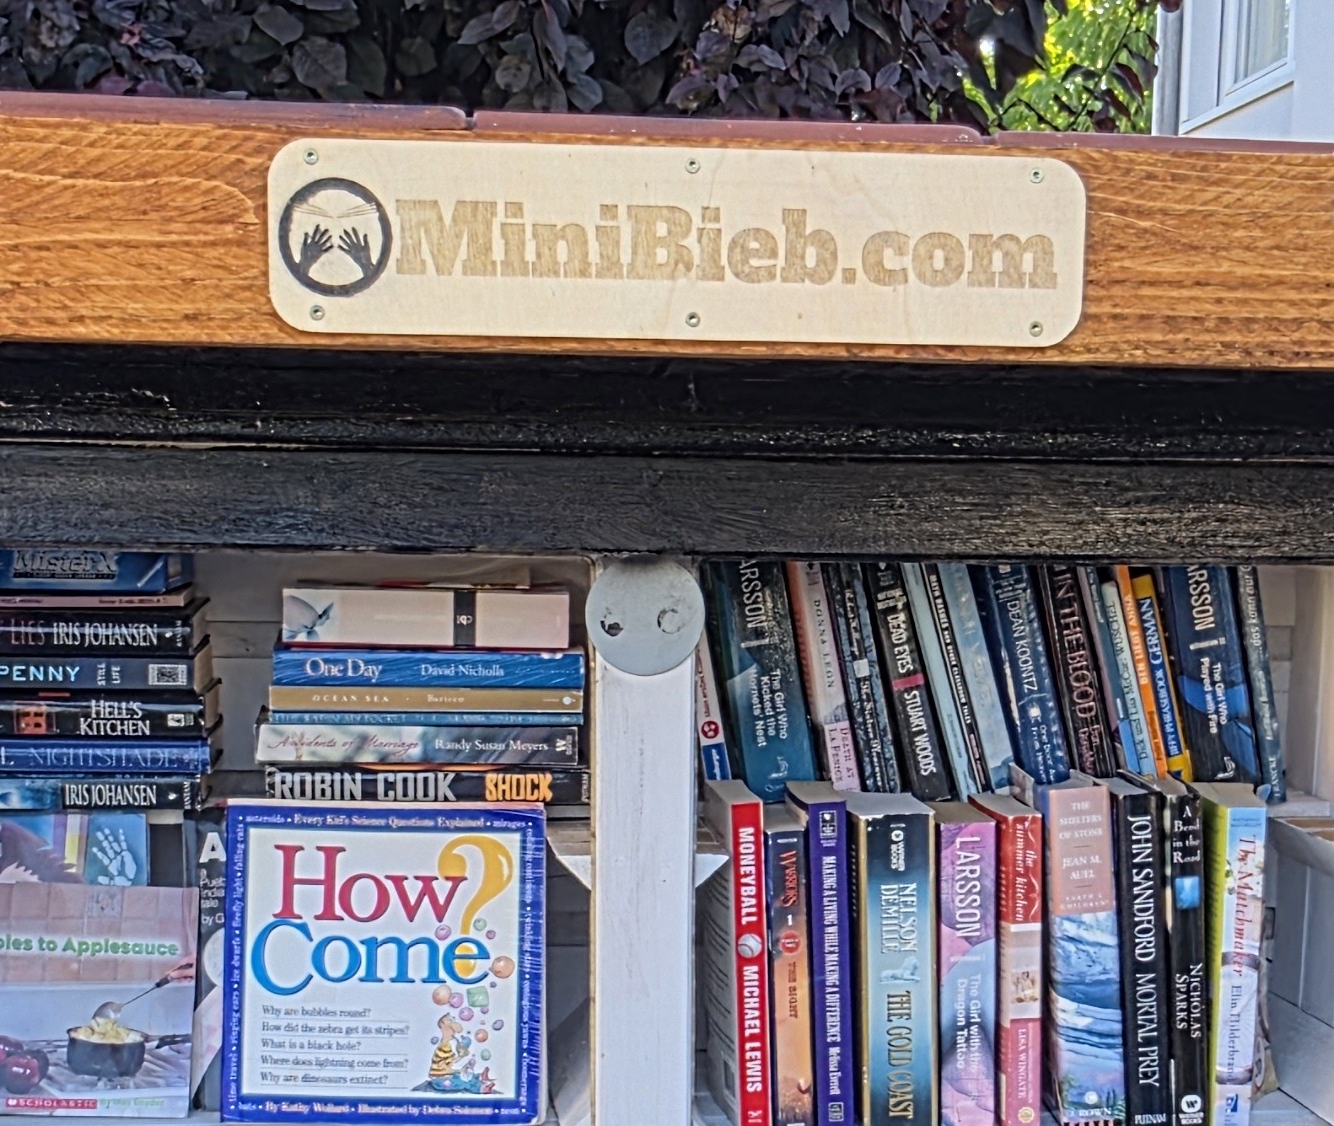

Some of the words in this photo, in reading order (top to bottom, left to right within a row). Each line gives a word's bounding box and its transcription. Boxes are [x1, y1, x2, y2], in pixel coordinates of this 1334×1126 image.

[395, 198, 1059, 291] MiniBieb.com
[11, 620, 45, 645] LIES
[53, 623, 80, 646] IRIS
[84, 623, 157, 647] JOHANSEN
[887, 614, 906, 644] DEAD
[1006, 601, 1028, 637] DEAN
[1059, 603, 1083, 645] THE
[1140, 597, 1164, 666] GERMAN
[814, 599, 828, 645] DONNA
[824, 653, 835, 689] LEON
[305, 658, 344, 677] One
[347, 658, 382, 682] Day
[421, 664, 455, 677] David
[458, 664, 504, 677] Nicholls
[895, 646, 913, 674] EYES
[1015, 641, 1038, 693] KOONTZ
[1200, 657, 1213, 691] Played
[1212, 663, 1223, 681] The
[770, 669, 781, 690] The
[1067, 651, 1097, 719] BLOOD
[1214, 683, 1226, 700] Girl
[92, 700, 142, 718] HELL'S
[761, 676, 773, 715] Kicked
[774, 693, 785, 712] Girl
[905, 690, 925, 732] STUART
[1153, 668, 1175, 734] PHRASEBOOK
[1205, 693, 1216, 713] with
[79, 719, 150, 736] KITCHEN
[766, 718, 777, 736] the
[777, 713, 788, 740] Who
[1208, 715, 1219, 734] Fire
[1218, 702, 1229, 725] Who
[28, 745, 178, 768] NIGHTSHADE
[914, 732, 937, 776] WOODS
[1167, 734, 1180, 756] JIFFY
[65, 784, 88, 805] IRIS
[89, 784, 157, 806] JOHANSEN
[274, 772, 362, 800] ROBIN
[377, 772, 458, 800] COOK
[485, 773, 553, 801] SHOCK
[1060, 815, 1103, 825] SHELTERS
[1070, 801, 1091, 810] THE
[1183, 805, 1192, 818] A
[1059, 831, 1072, 840] OF
[1074, 829, 1103, 838] STONE
[1174, 818, 1200, 832] Bend
[1016, 823, 1027, 873] summer
[1128, 815, 1155, 867] JOHN
[1173, 837, 1183, 847] in
[1186, 835, 1200, 846] the
[1238, 834, 1256, 866] The
[823, 855, 836, 888] MAKING
[1025, 849, 1037, 867] the
[1173, 850, 1200, 864] Road
[272, 843, 468, 923] How
[738, 827, 759, 925] MONEYBALL
[955, 837, 981, 938] LARSSON
[1070, 871, 1095, 880] AUEL
[823, 896, 837, 925] LIVING
[1015, 875, 1028, 922] kitchen
[881, 884, 899, 954] DEMILLE
[898, 882, 917, 952] NELSON
[1133, 869, 1155, 962] SANDFORD
[1232, 869, 1255, 977] Matchmaker
[38, 937, 57, 951] to
[62, 937, 179, 956] Applesauce
[824, 925, 838, 952] WHILE
[250, 919, 491, 997] Come
[825, 953, 839, 985] MAKING
[262, 1004, 279, 1017] Why
[282, 1007, 298, 1016] are
[301, 1006, 338, 1017] bubbles
[340, 1007, 372, 1018] round?
[744, 966, 760, 1032] MICHAEL
[887, 990, 912, 1022] THE
[955, 978, 969, 1026] Dragon
[1136, 973, 1158, 1044] MORTAL
[1175, 973, 1189, 1031] SPARKS
[1189, 963, 1204, 1039] NICHOLAS
[1230, 984, 1242, 1011] Elin
[261, 1022, 279, 1032] How
[283, 1023, 299, 1032] did
[301, 1024, 317, 1034] the
[319, 1025, 343, 1034] zebra
[345, 1025, 359, 1036] get
[362, 1025, 373, 1034] its
[375, 1025, 409, 1037] stripes?
[826, 994, 840, 1042] DIFFERENCE
[261, 1038, 285, 1049] What
[289, 1039, 297, 1049] is
[299, 1041, 306, 1049] a
[308, 1040, 333, 1050] black
[335, 1041, 361, 1051] hole?
[887, 1027, 912, 1067] GOLD
[956, 1028, 969, 1069] Tattoo
[1018, 1028, 1027, 1049] LISA
[1227, 1013, 1241, 1082] Hilderbrand
[261, 1055, 289, 1066] Where
[292, 1057, 313, 1067] does
[314, 1057, 354, 1070] lightning
[356, 1060, 381, 1068] come
[383, 1059, 408, 1069] from?
[745, 1040, 762, 1093] LEWIS
[828, 1046, 841, 1071] Melissa
[1137, 1046, 1159, 1088] PREY
[261, 1073, 279, 1085] Why
[282, 1075, 298, 1083] are
[301, 1073, 348, 1084] dinosaurs
[349, 1075, 388, 1085] extinct?
[829, 1072, 841, 1095] Everett
[1017, 1051, 1028, 1099] WINGATE
[887, 1072, 913, 1120] COAST
